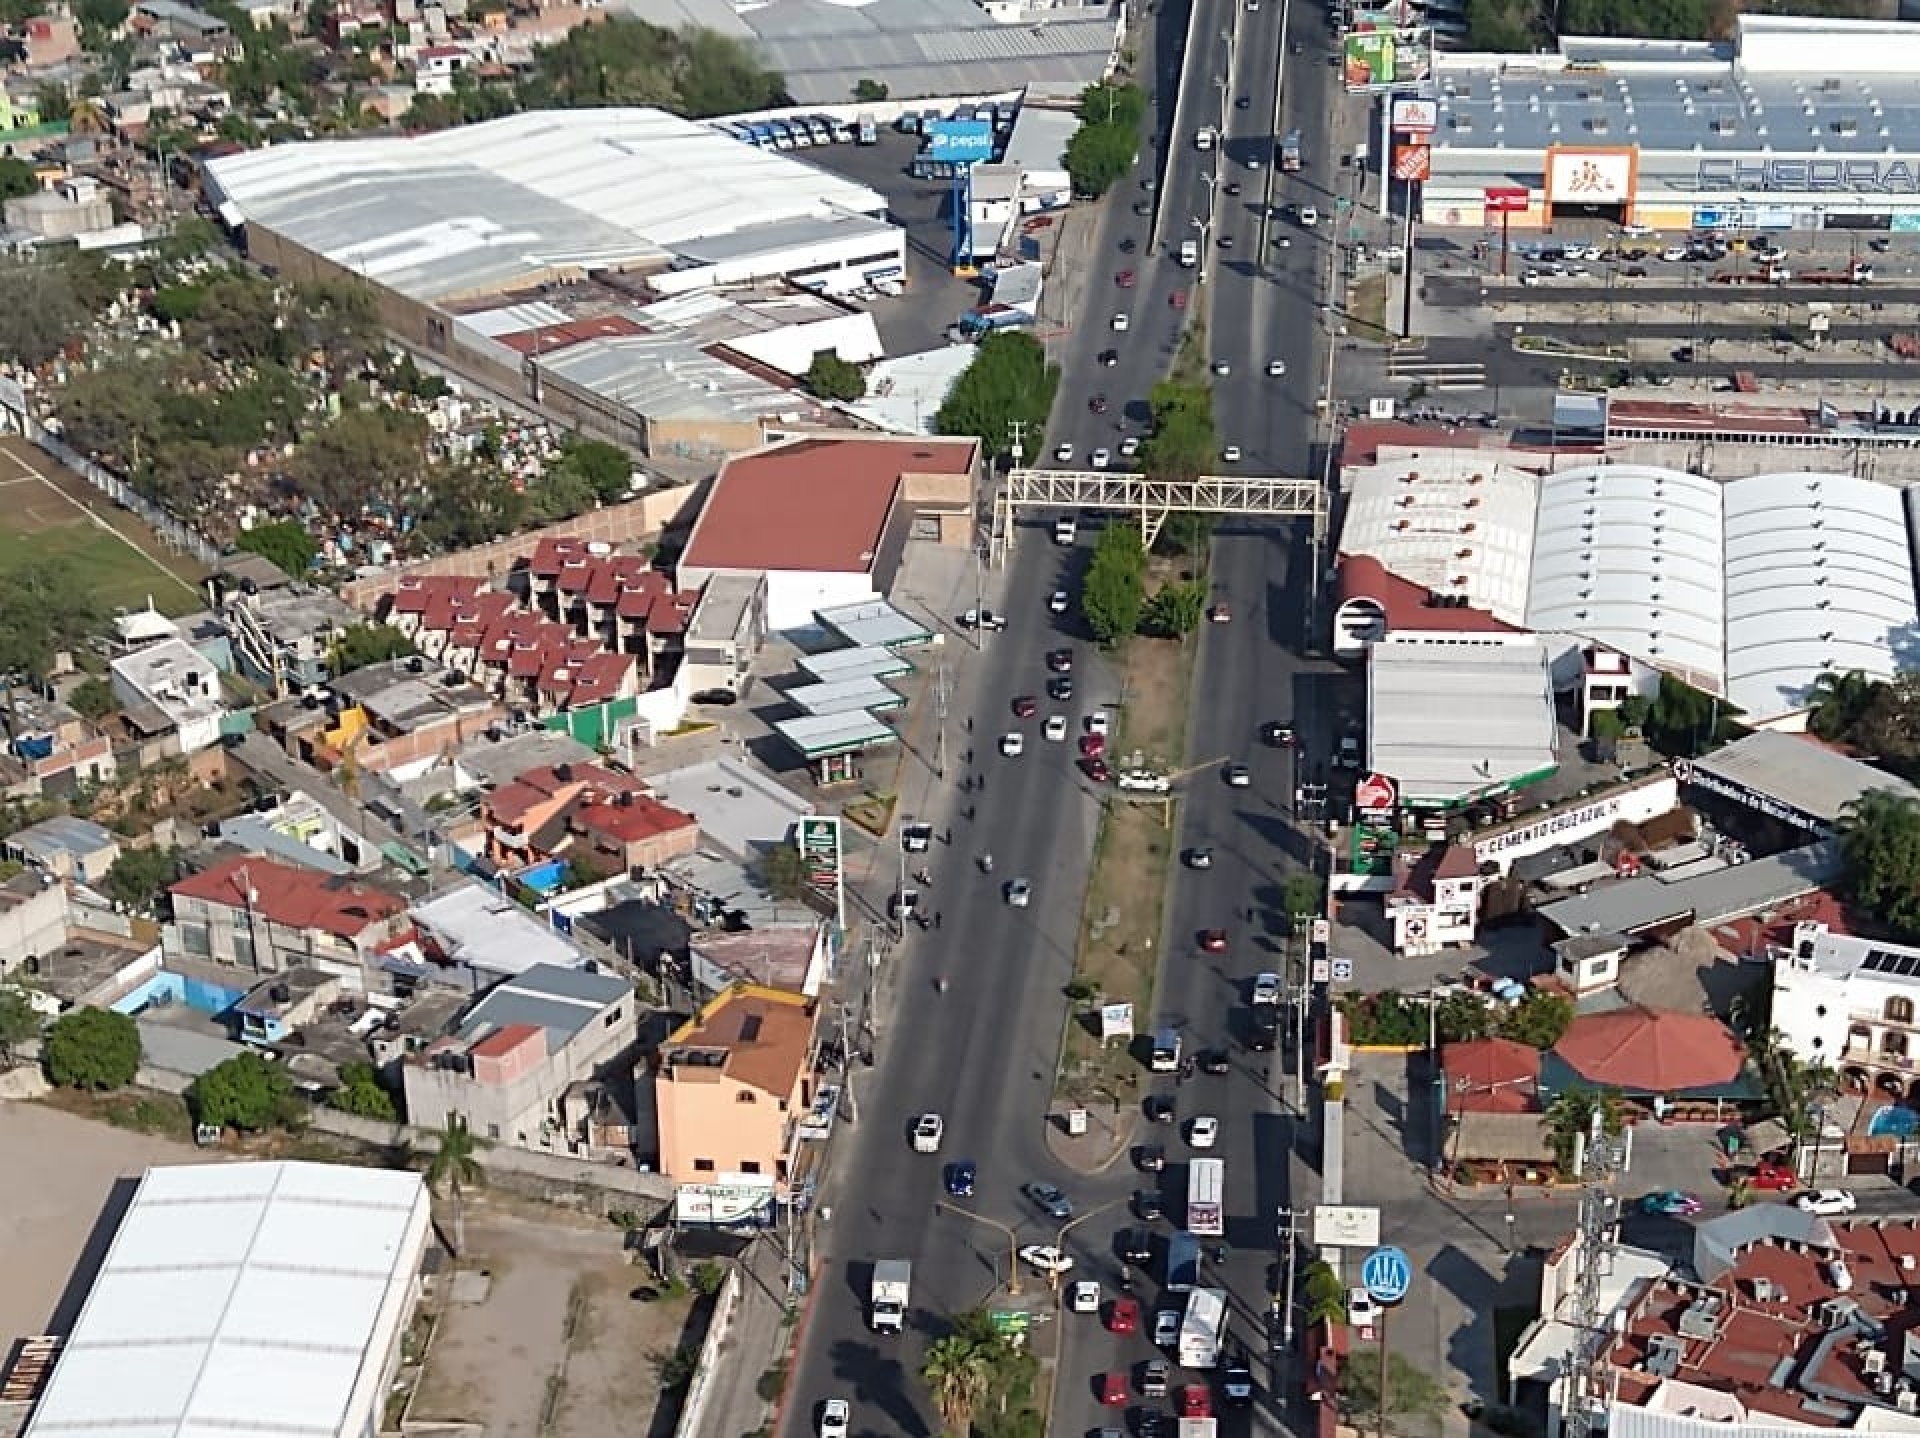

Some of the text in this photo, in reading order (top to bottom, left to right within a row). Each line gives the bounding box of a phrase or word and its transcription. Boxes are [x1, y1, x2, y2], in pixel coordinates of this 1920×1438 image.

[950, 135, 987, 148] pepsi
[1699, 158, 1920, 192] CHEDRA
[1489, 804, 1606, 852] CEMENTO CRUZ AZUL
